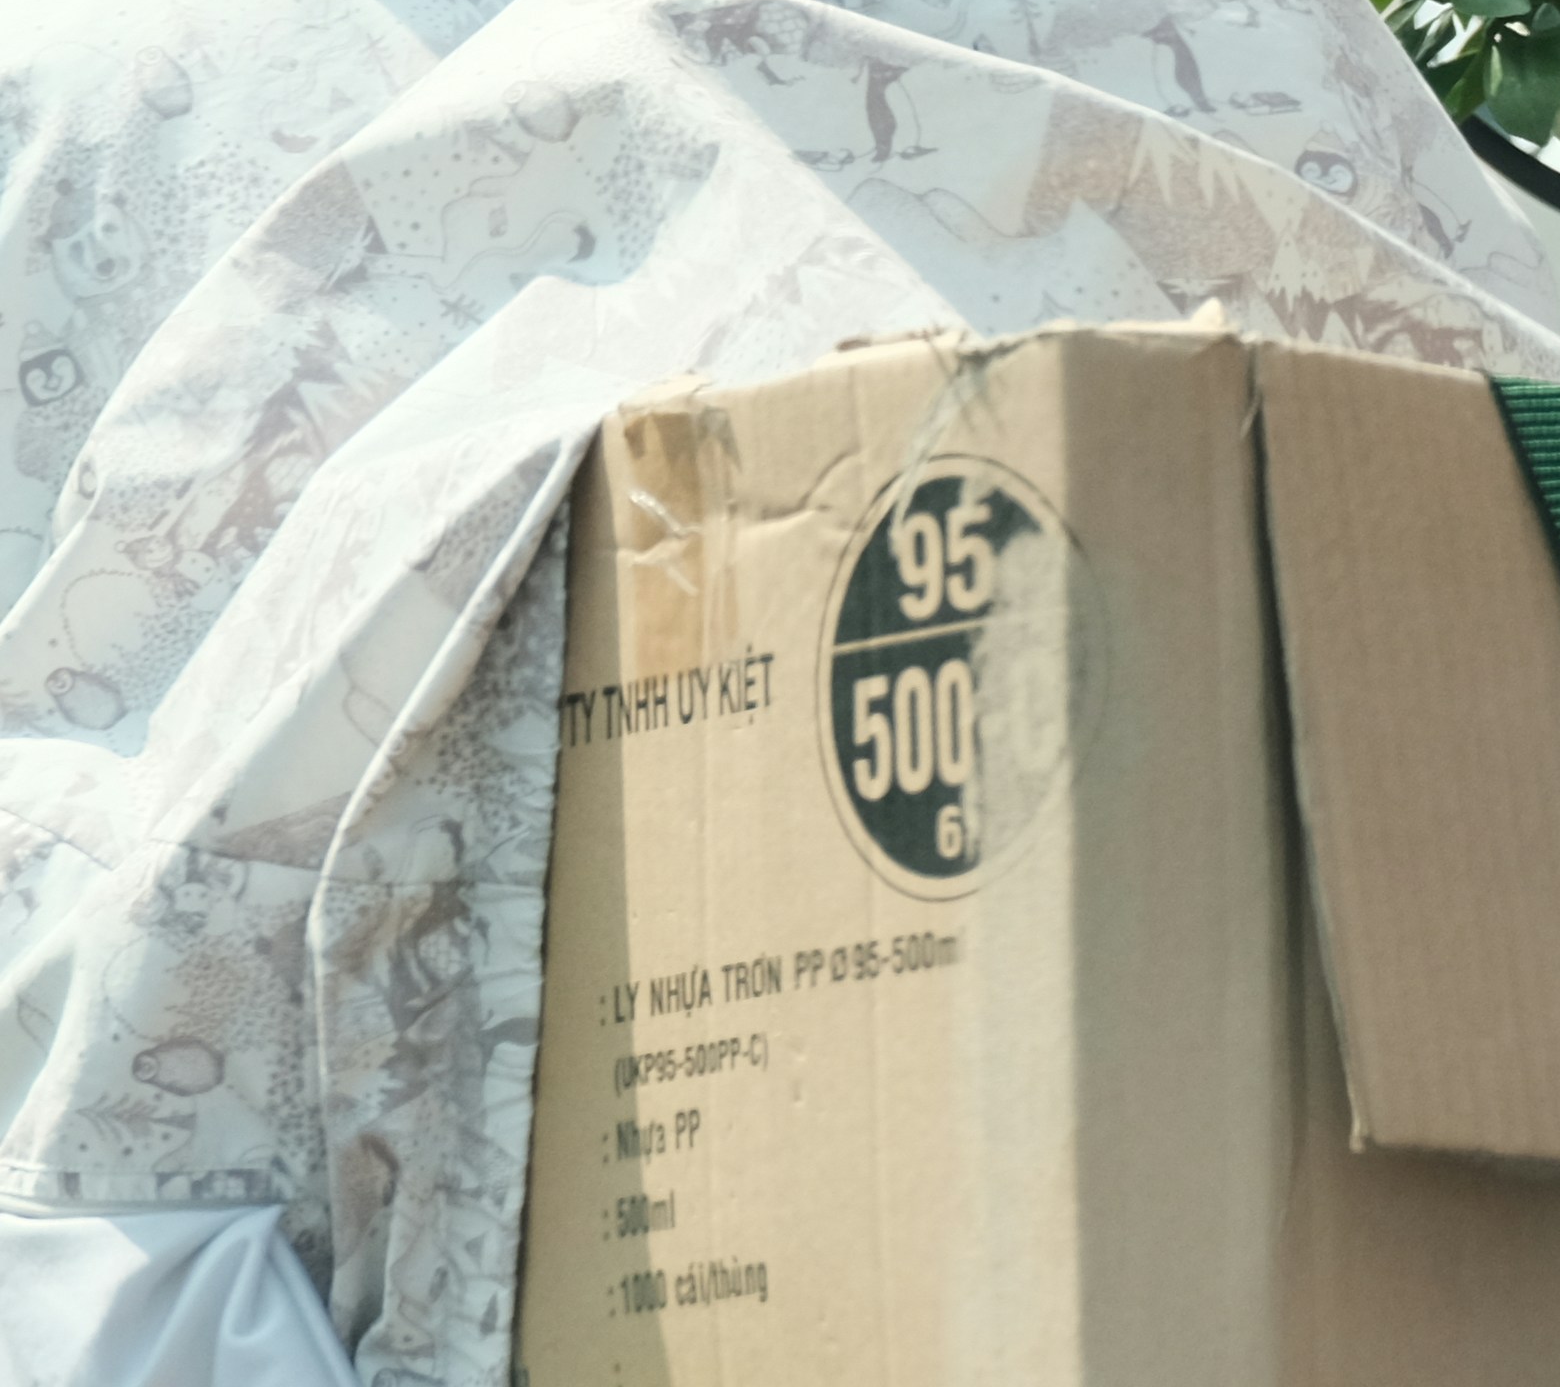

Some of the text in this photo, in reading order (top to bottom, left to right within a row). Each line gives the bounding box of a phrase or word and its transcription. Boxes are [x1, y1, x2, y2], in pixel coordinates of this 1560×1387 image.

[899, 501, 996, 621] 95
[558, 689, 596, 747] TY
[603, 673, 669, 740] TNHH
[613, 982, 640, 1024] LY
[649, 964, 712, 1019] NHỰA
[794, 947, 825, 990] PP
[675, 1108, 700, 1151] PP
